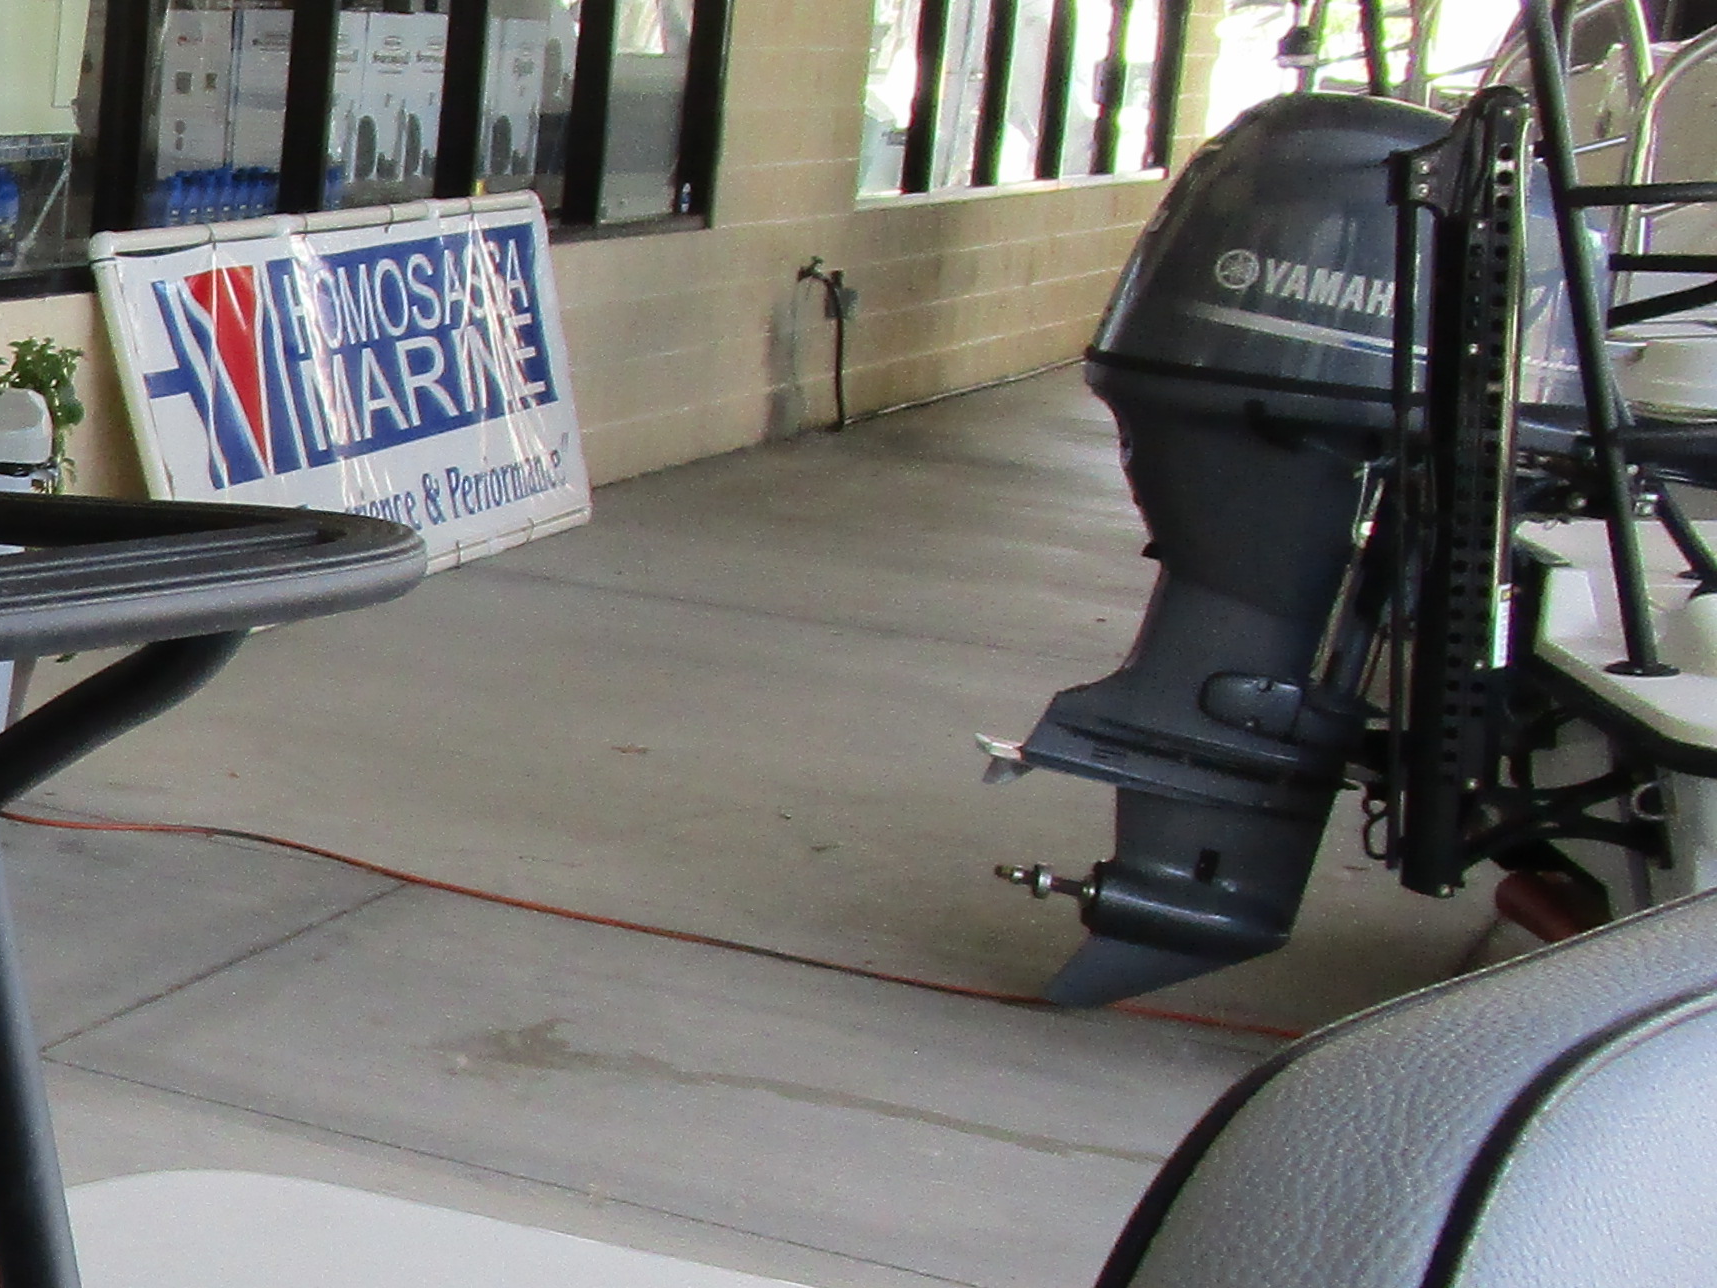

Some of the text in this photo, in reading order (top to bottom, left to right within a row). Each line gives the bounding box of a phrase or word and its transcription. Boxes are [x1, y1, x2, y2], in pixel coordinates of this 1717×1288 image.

[1265, 258, 1395, 317] YAMAH
[299, 313, 547, 451] MARINE
[421, 472, 447, 526] &
